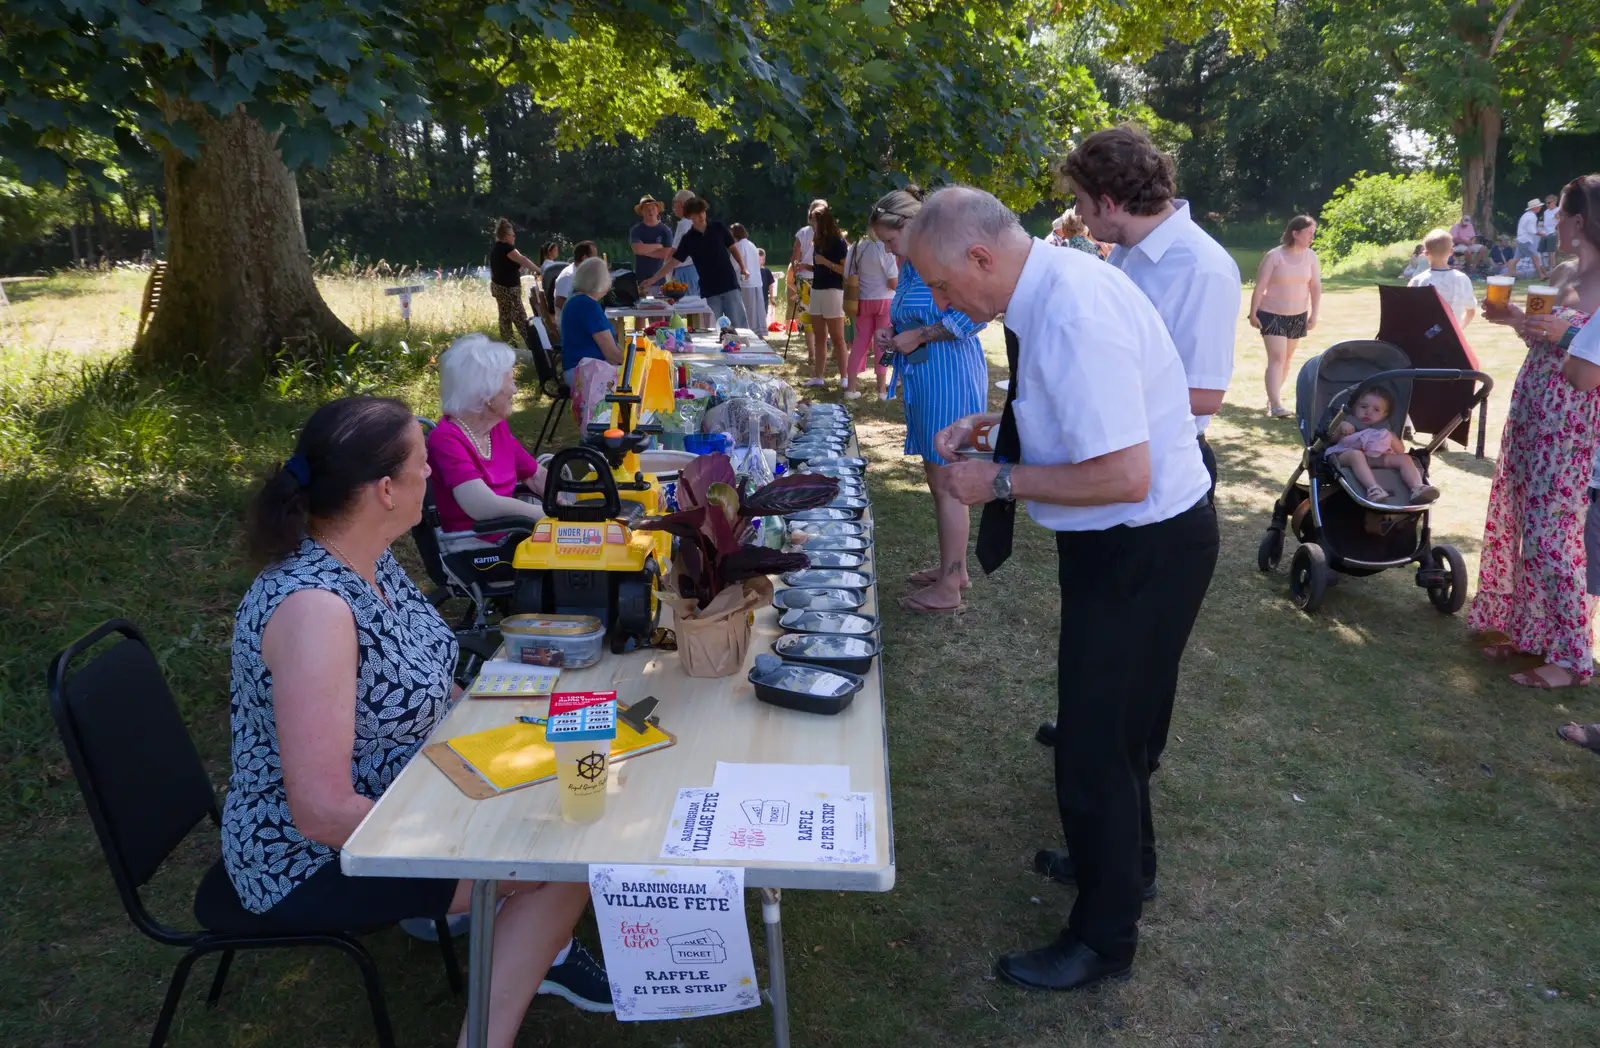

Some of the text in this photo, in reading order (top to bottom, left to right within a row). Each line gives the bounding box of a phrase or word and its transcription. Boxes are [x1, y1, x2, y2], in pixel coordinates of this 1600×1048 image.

[558, 528, 581, 536] UNDER
[681, 802, 700, 841] BARNINGHAM
[692, 792, 720, 852] VILLAGE FETE
[769, 806, 780, 823] TICKET
[797, 810, 814, 841] RAFFLE
[820, 803, 836, 850] £1 PER STRIP
[621, 882, 707, 895] BARNINGHAM
[603, 893, 730, 912] VILLAGE FETE
[620, 920, 659, 935] Enter
[645, 970, 710, 981] RAFFLE
[633, 983, 728, 995] £1 PER STRIP
